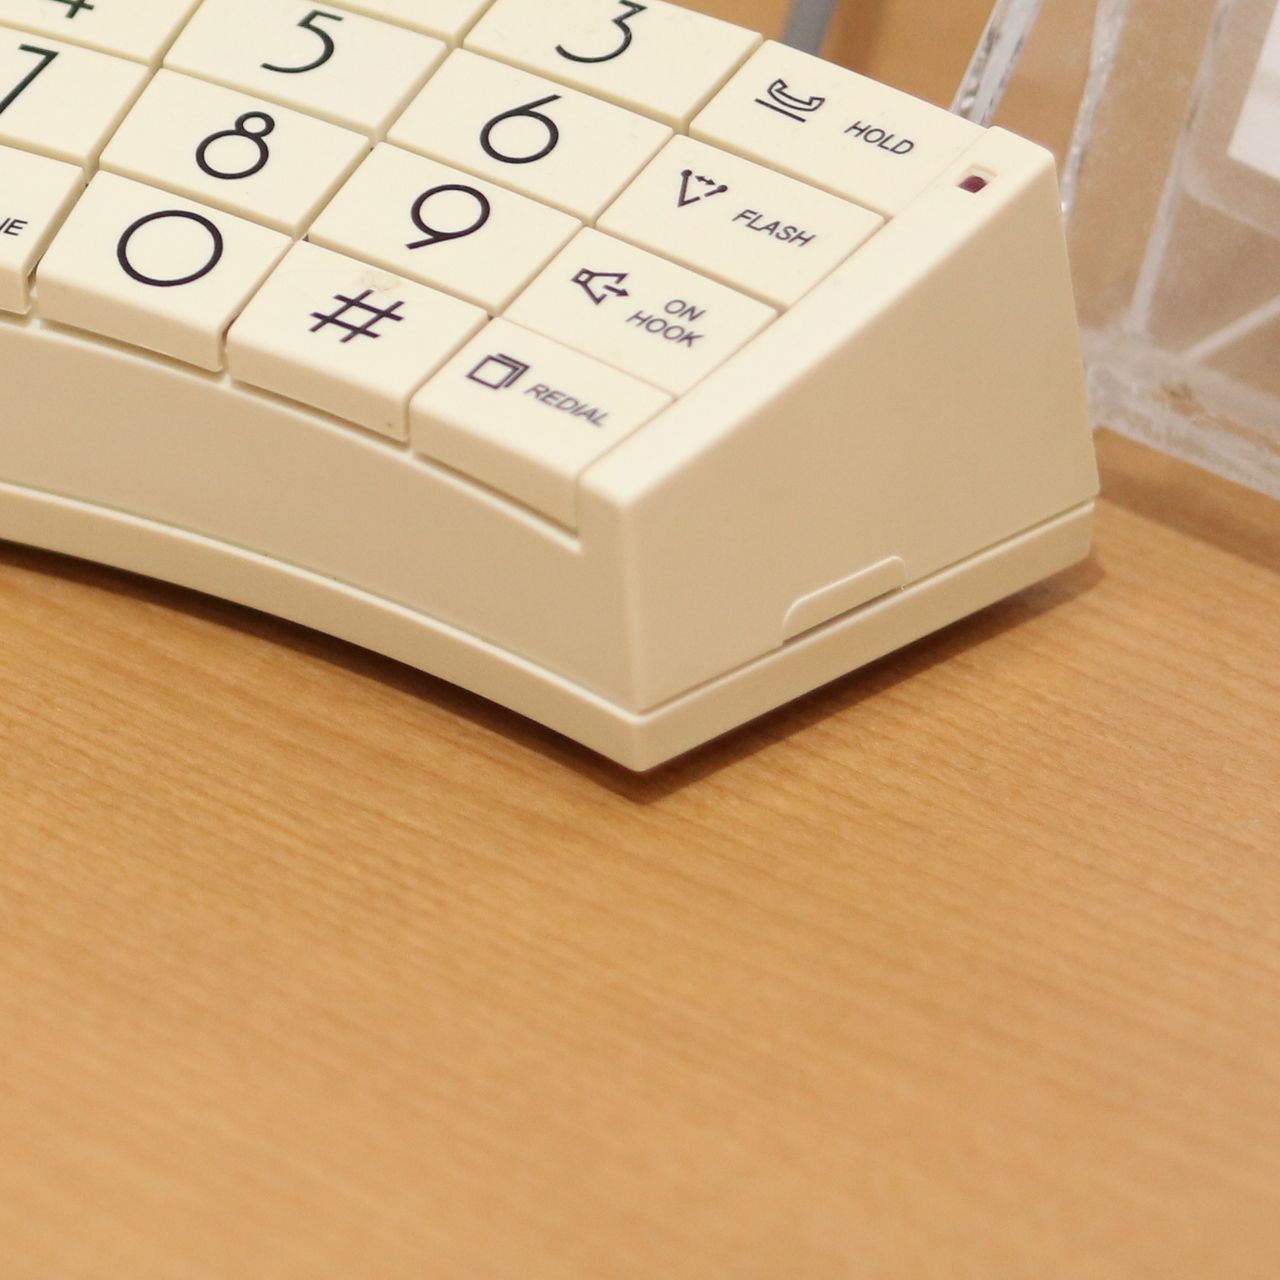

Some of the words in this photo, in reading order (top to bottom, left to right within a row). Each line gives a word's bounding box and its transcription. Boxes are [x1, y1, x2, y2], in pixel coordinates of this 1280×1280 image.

[260, 9, 344, 74] 5
[195, 111, 276, 181] 8
[479, 94, 562, 165] 6
[843, 120, 915, 155] HOLD
[405, 183, 491, 250] 9
[732, 209, 816, 247] FLASH
[309, 289, 405, 344] #
[626, 311, 705, 348] HOOK
[664, 299, 706, 322] ON
[524, 383, 608, 427] REDIAL
